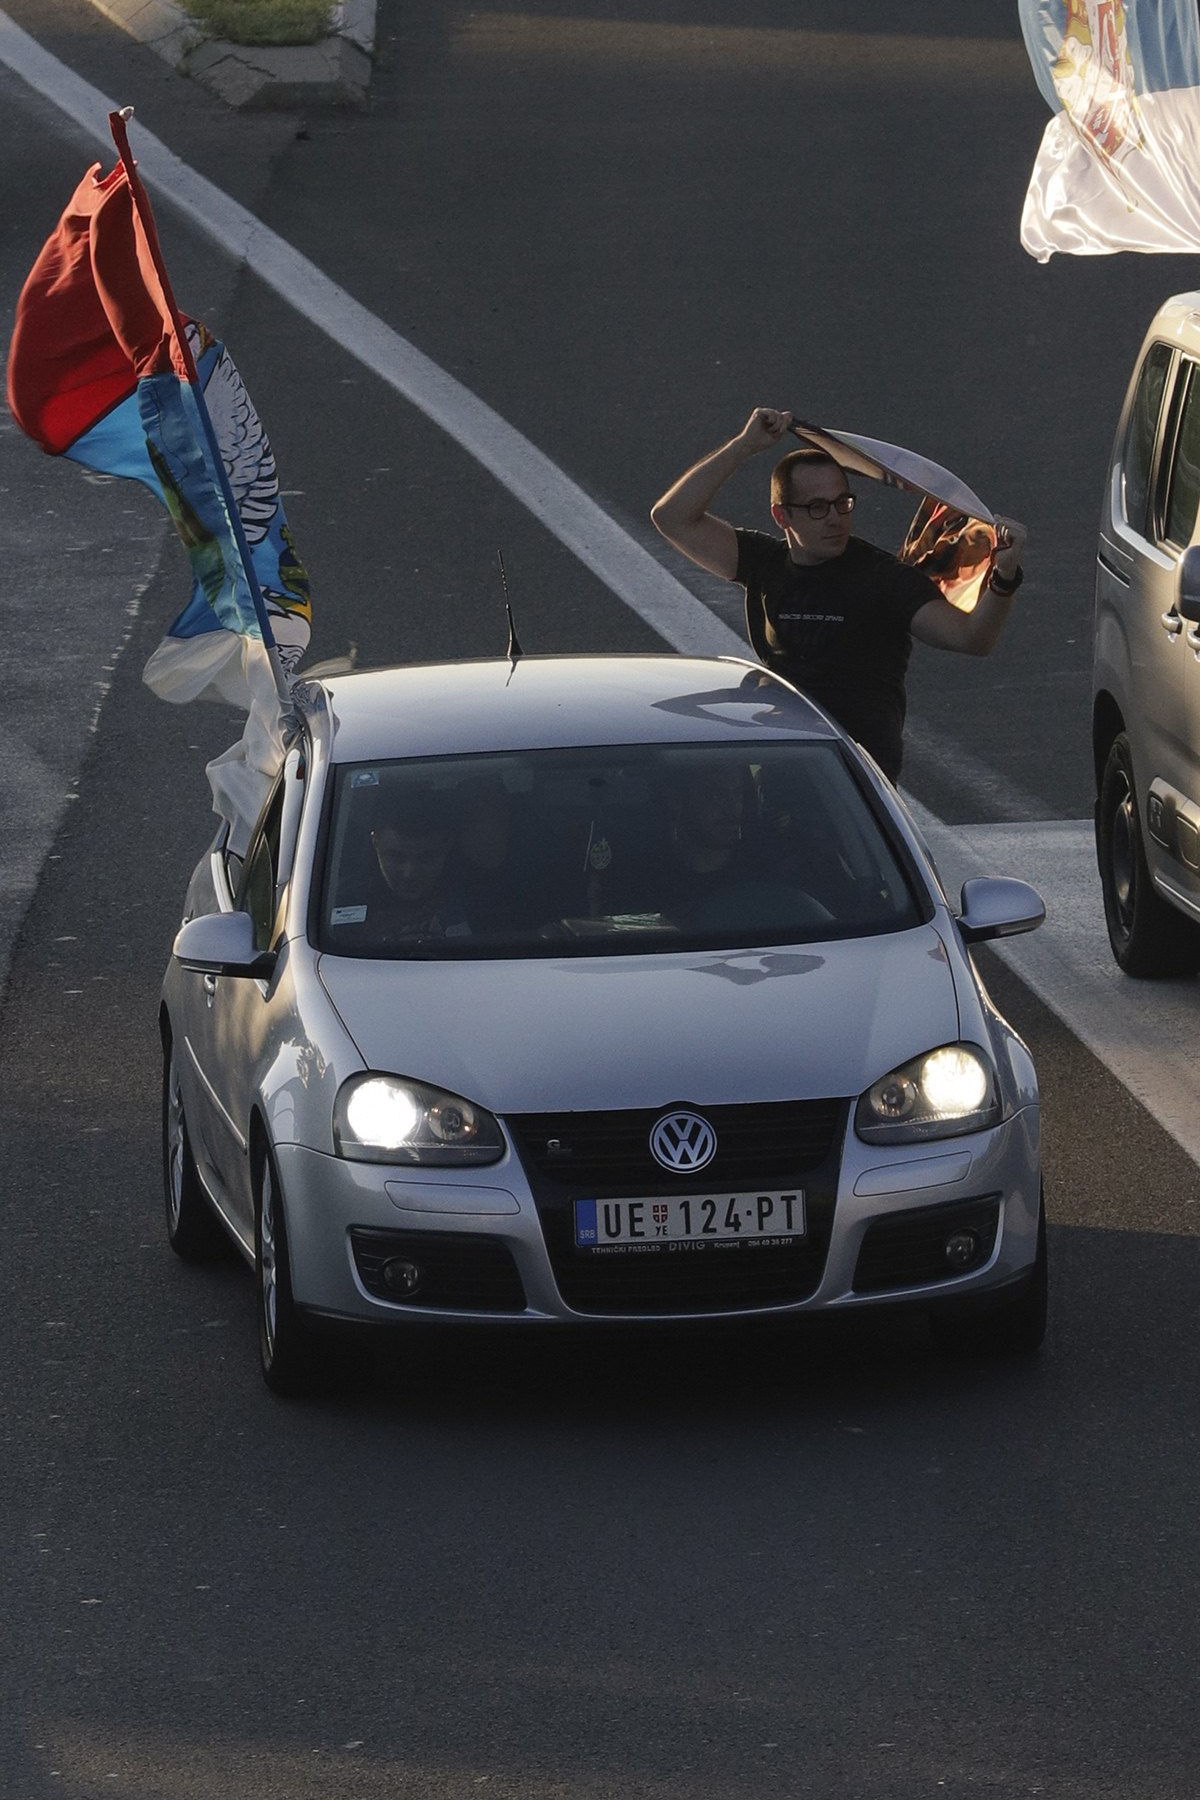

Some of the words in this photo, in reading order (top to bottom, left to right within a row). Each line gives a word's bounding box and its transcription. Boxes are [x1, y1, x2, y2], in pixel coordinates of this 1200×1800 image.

[603, 1203, 645, 1238] UE
[579, 1229, 596, 1239] SRB
[668, 1241, 706, 1252] DIVIG
